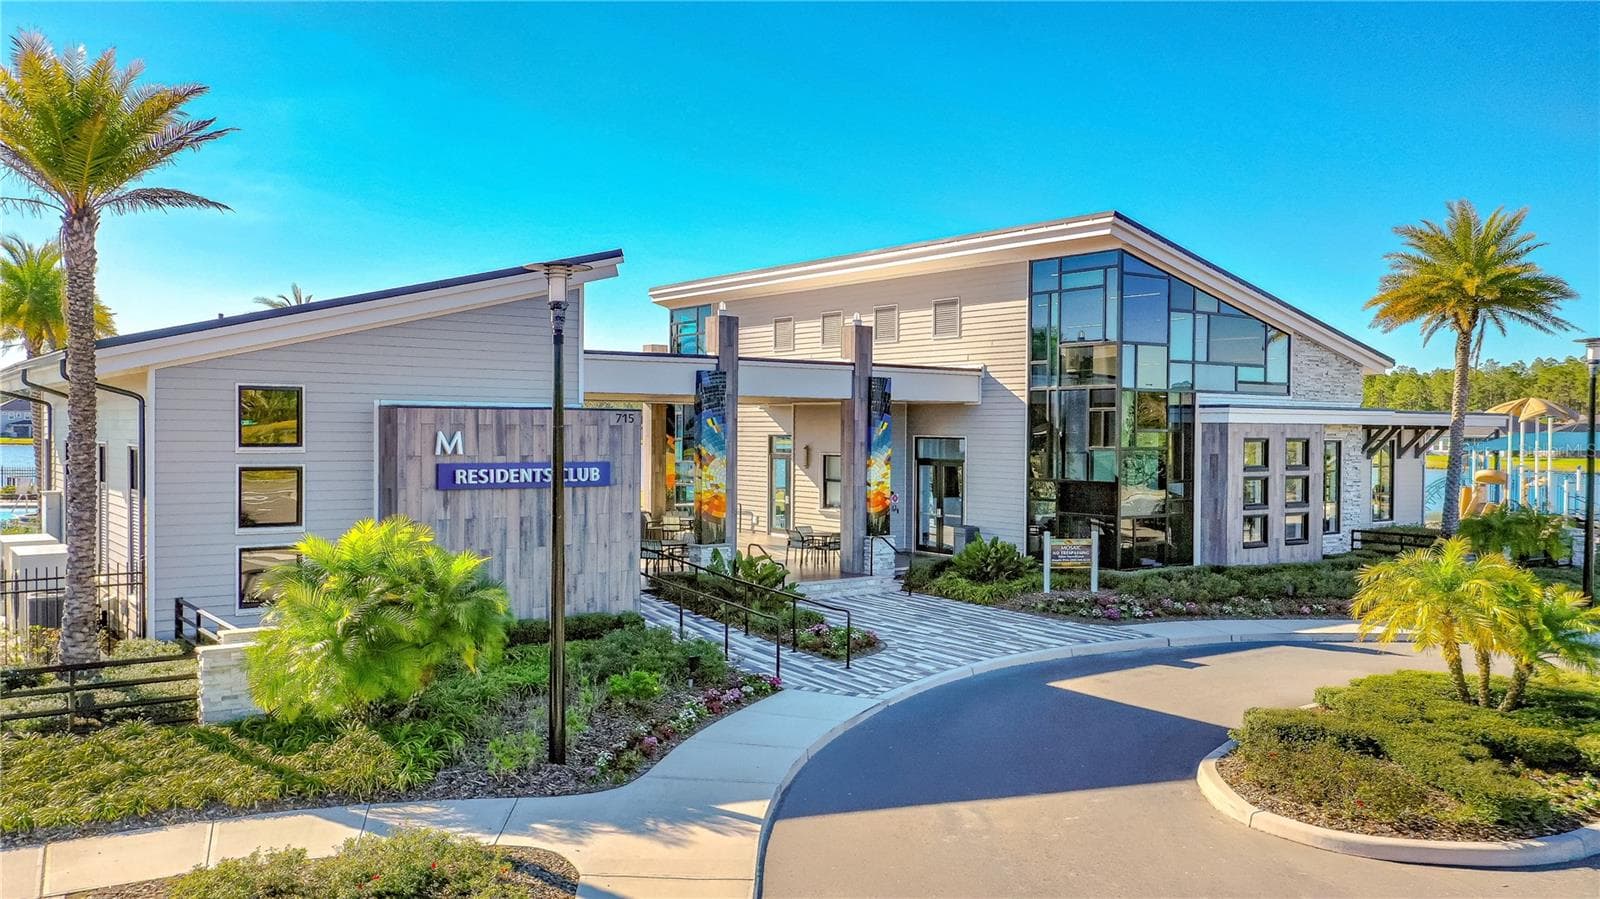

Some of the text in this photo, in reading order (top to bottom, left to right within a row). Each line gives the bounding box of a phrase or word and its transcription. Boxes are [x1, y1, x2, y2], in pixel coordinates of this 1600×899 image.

[615, 413, 634, 424] 715
[435, 430, 464, 456] M
[455, 467, 553, 484] RESIDENTS
